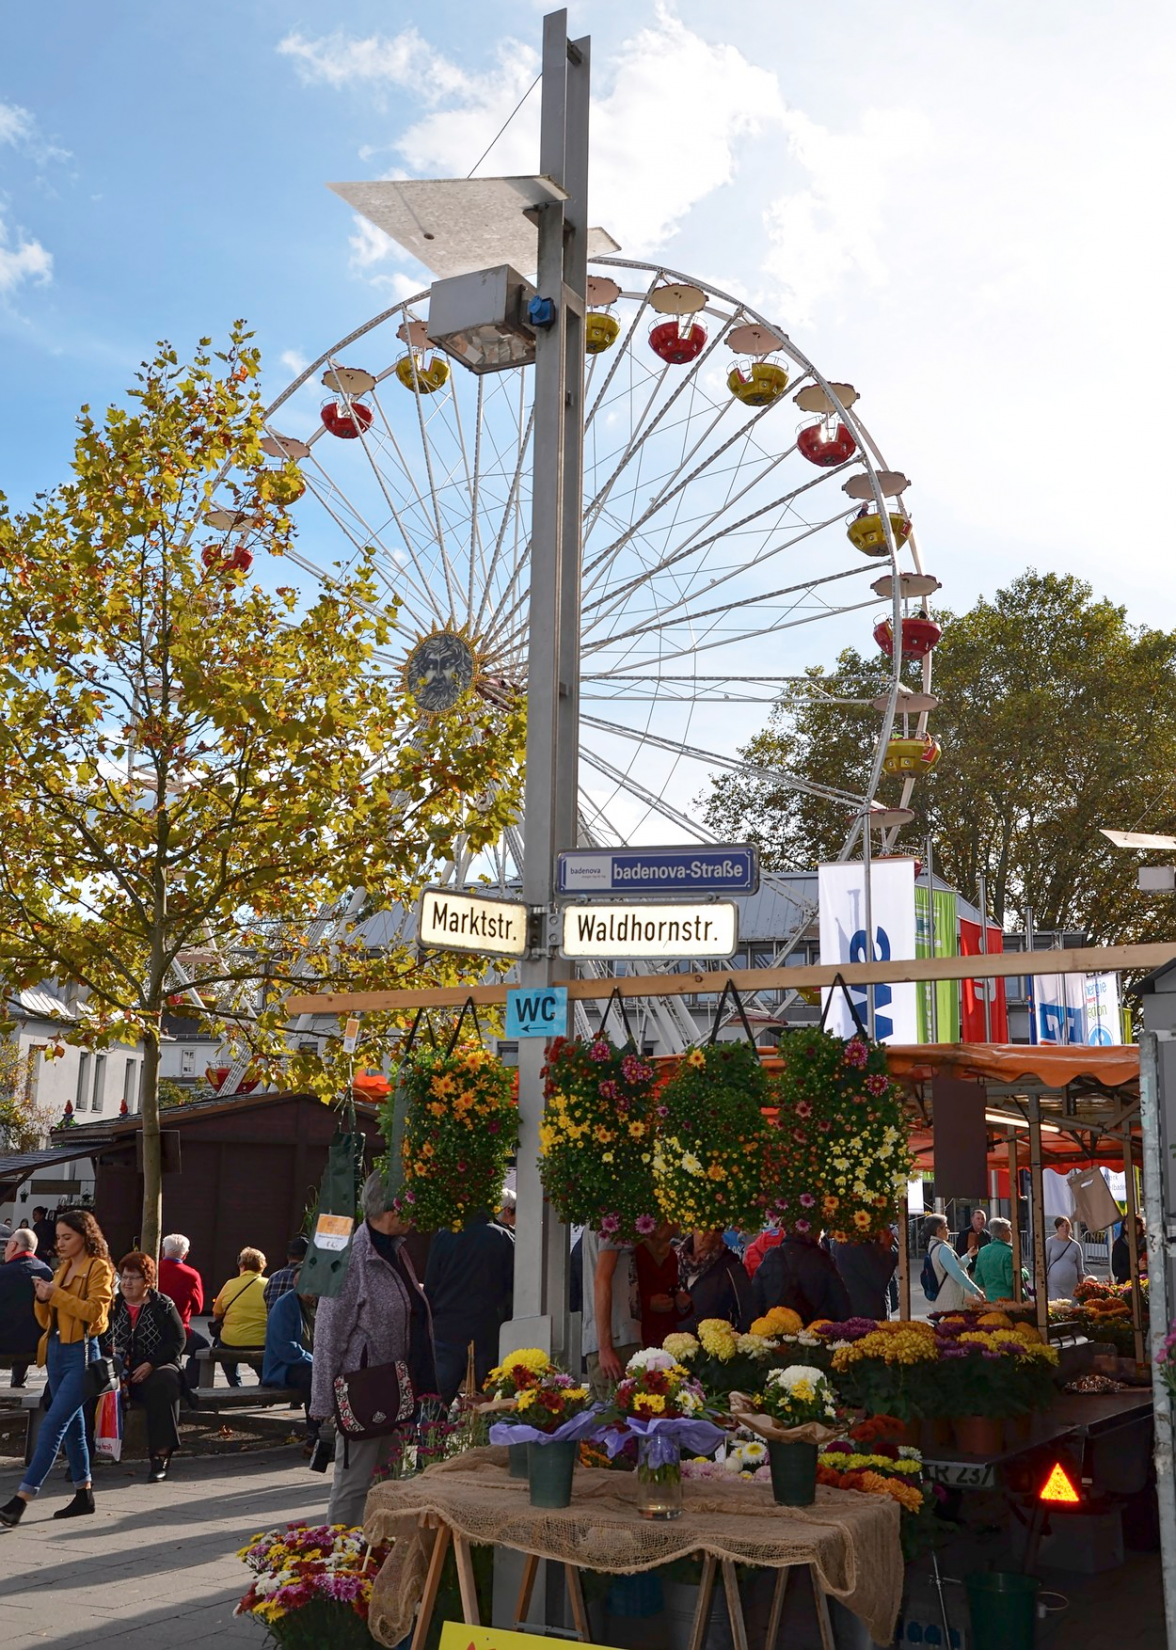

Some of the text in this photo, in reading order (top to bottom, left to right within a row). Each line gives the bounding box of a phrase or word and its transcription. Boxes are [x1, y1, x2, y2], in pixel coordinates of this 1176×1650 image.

[570, 867, 601, 875] badenova
[613, 860, 743, 880] badenova-Straße
[432, 901, 517, 941] Marktstr.
[577, 914, 718, 942] Waldhornstr.
[515, 996, 556, 1022] WC
